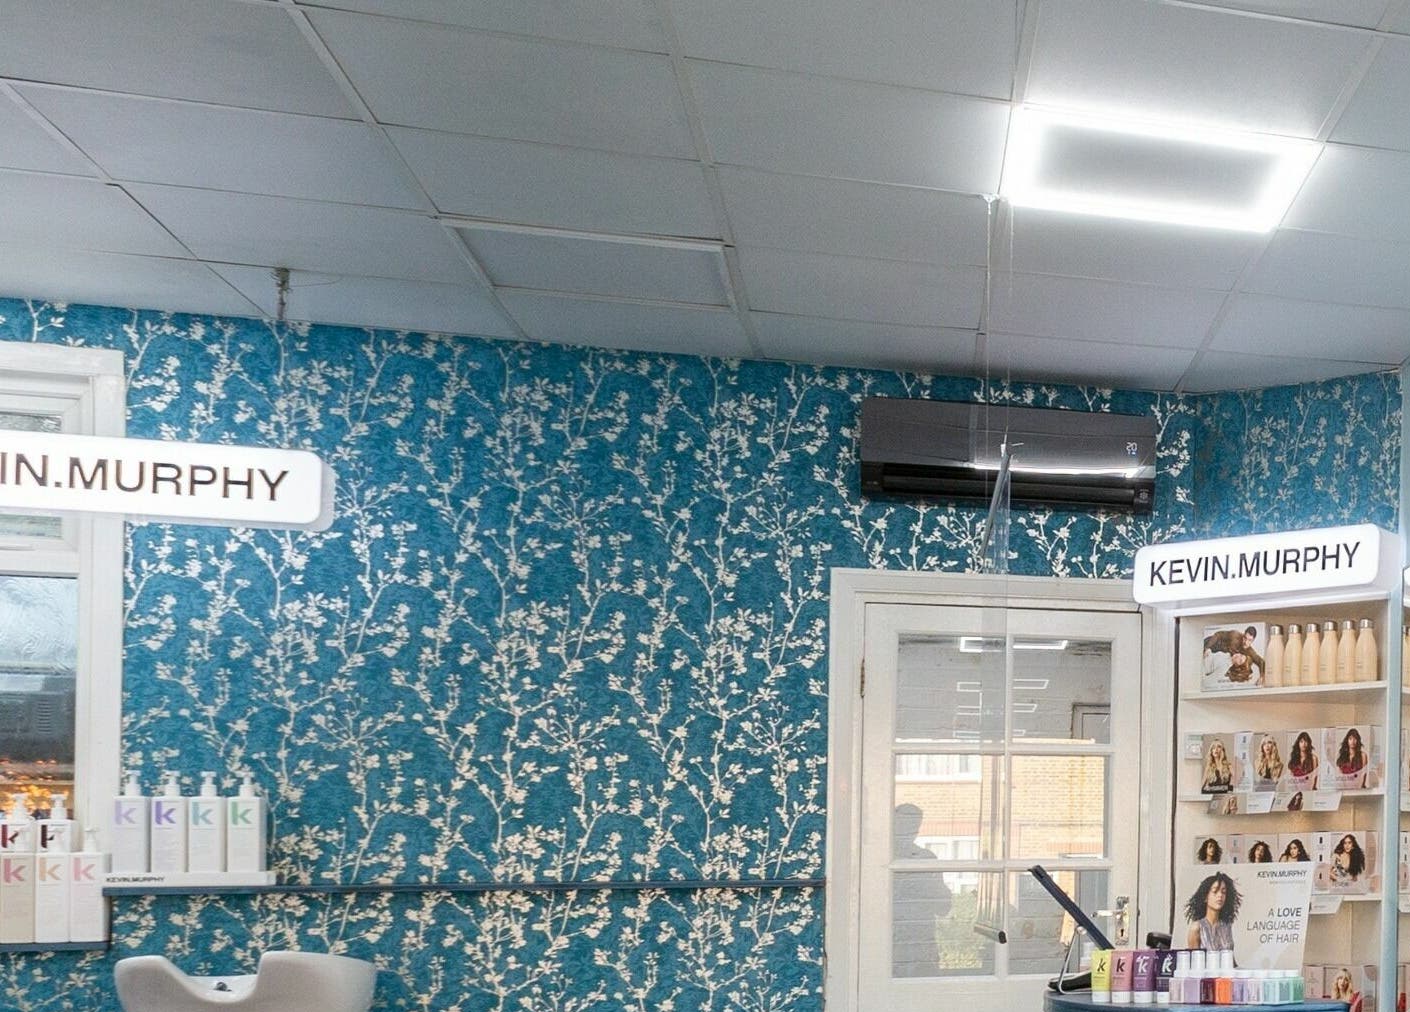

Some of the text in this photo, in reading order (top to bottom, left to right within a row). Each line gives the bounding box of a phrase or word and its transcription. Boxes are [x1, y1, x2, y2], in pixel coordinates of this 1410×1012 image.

[0, 453, 289, 501] IN.MURPHY
[1149, 541, 1361, 587] KEVIN.MURPHY
[115, 800, 136, 825] k
[155, 801, 176, 825] k
[192, 801, 213, 825] k
[231, 801, 252, 825] k
[3, 859, 26, 883] k
[40, 857, 61, 881] k
[74, 857, 96, 881] k
[1268, 907, 1302, 917] A LOVE
[1247, 920, 1300, 931] LANGUAGE
[1259, 933, 1299, 944] OF HAIR
